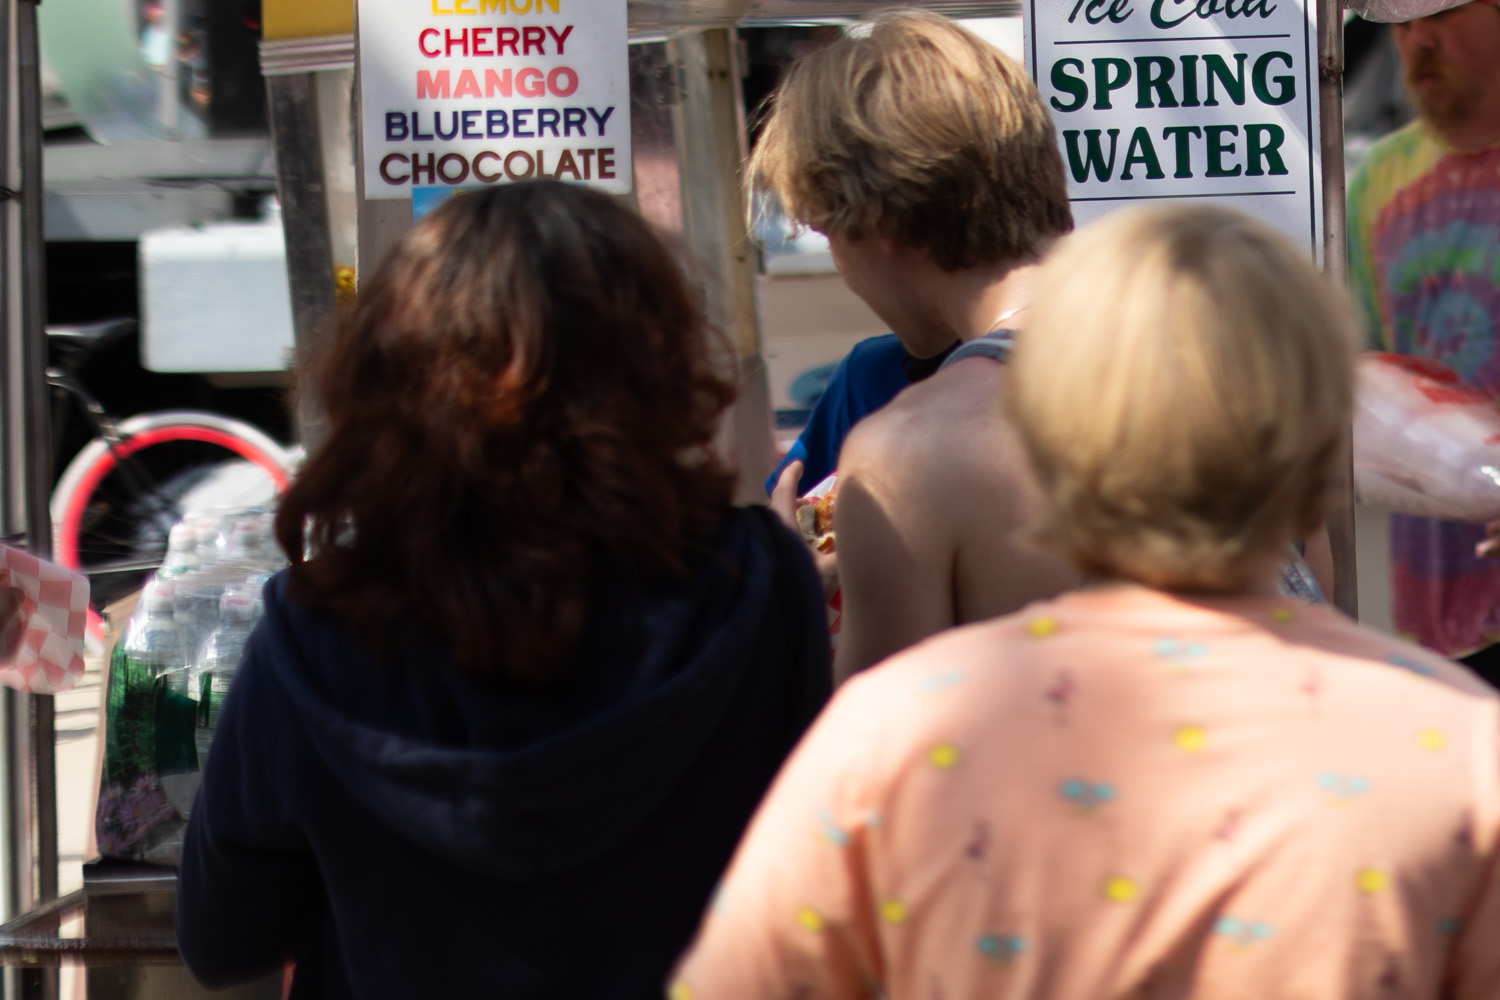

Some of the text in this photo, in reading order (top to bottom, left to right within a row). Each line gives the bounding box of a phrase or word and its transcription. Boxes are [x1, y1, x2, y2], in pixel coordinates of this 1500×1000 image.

[418, 25, 574, 58] CHERRY
[416, 66, 579, 100] MANGO
[1049, 50, 1296, 113] SPRING
[384, 106, 616, 142] BLUEBERRY
[378, 147, 617, 186] CHOCOLATE
[1061, 122, 1290, 184] WATER
